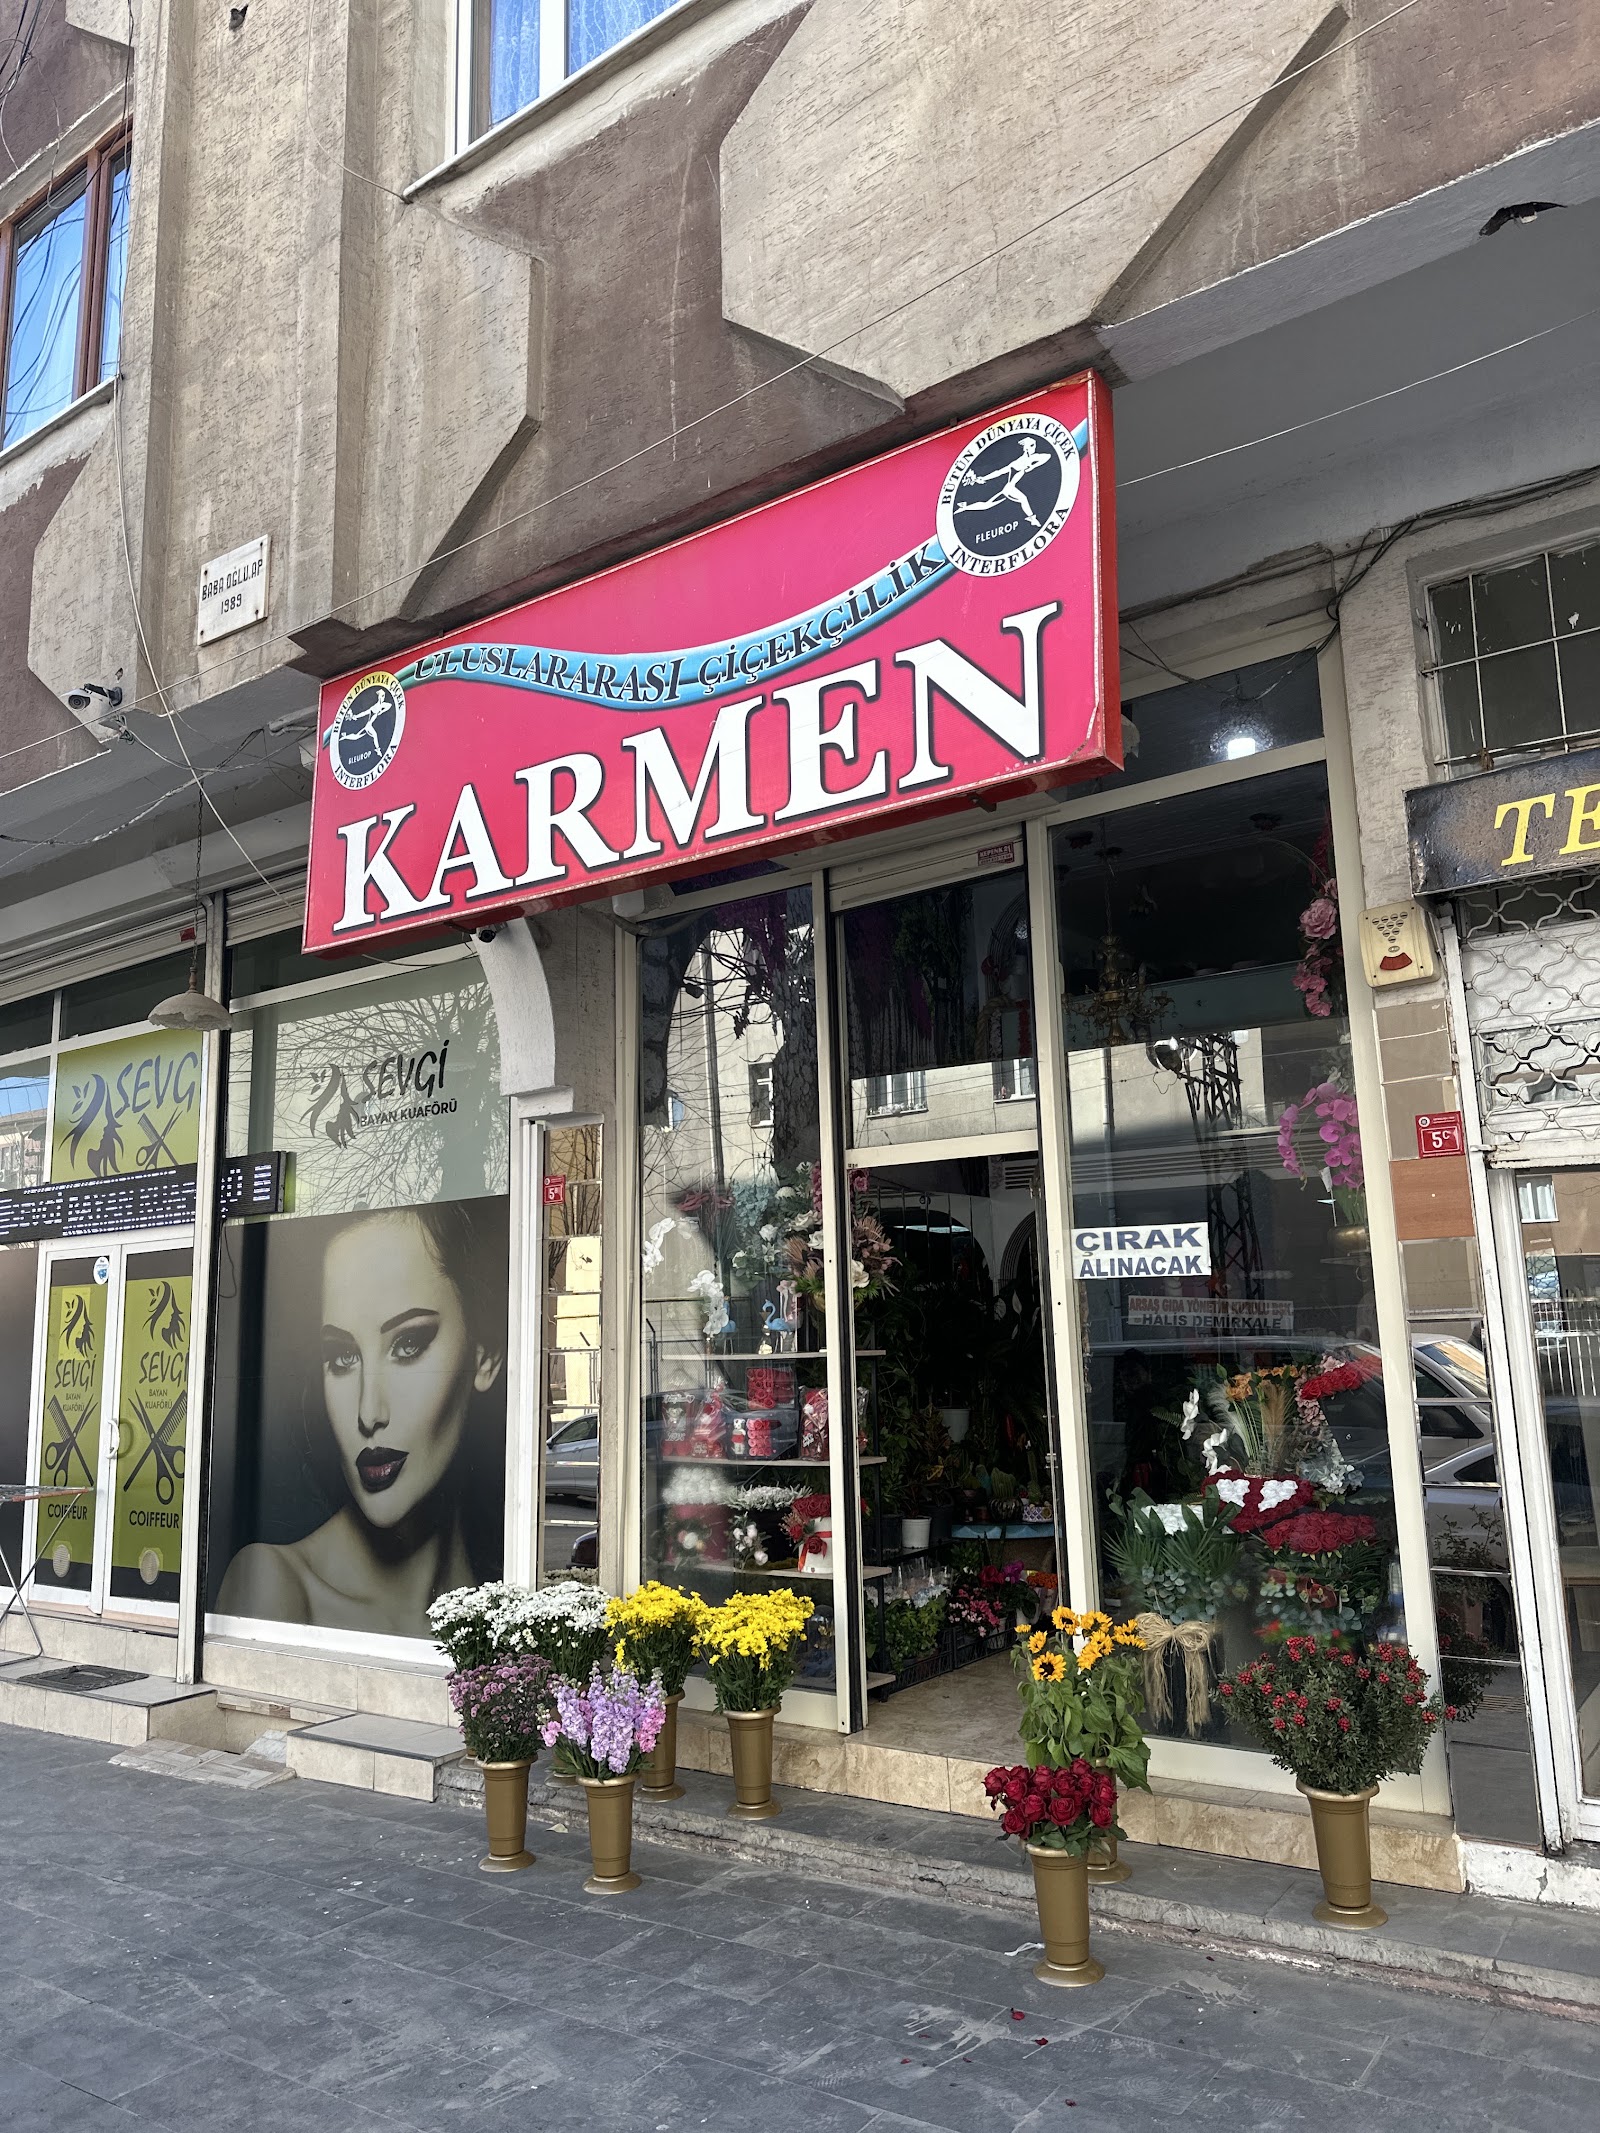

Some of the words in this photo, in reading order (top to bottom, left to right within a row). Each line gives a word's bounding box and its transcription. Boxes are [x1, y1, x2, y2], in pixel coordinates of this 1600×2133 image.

[941, 450, 974, 505] BÜTÜN
[976, 418, 1041, 450] DÜNYAYA
[1044, 422, 1076, 461] ÇİÇEK
[949, 507, 1069, 574] INTERFLORA
[975, 521, 1019, 544] FLEUROP
[202, 577, 224, 601] BABA
[221, 593, 242, 615] 1989
[414, 646, 686, 704] ULUSLARARASI
[698, 542, 946, 694] ÇİÇEKÇİLİK
[333, 601, 1062, 935] KARMEN
[335, 744, 398, 788] INTERFLORA
[1494, 783, 1600, 867] TE
[362, 1039, 449, 1104] SEVGİ
[360, 1111, 398, 1127] BAYAN
[400, 1098, 458, 1121] KUAFÖRÜ
[1075, 1227, 1203, 1257] ÇIRAK
[1079, 1255, 1203, 1277] ALINACAK
[1162, 1298, 1185, 1312] GIDA
[1142, 1313, 1188, 1326] HALİS
[1192, 1314, 1281, 1329] DEMİRKALE
[54, 1354, 97, 1392] SEVGİ
[66, 1393, 82, 1401] BAYAN
[149, 1389, 168, 1397] BAYAN
[47, 1504, 88, 1520] COIFFEUR
[129, 1510, 180, 1529] COIFFEUR
